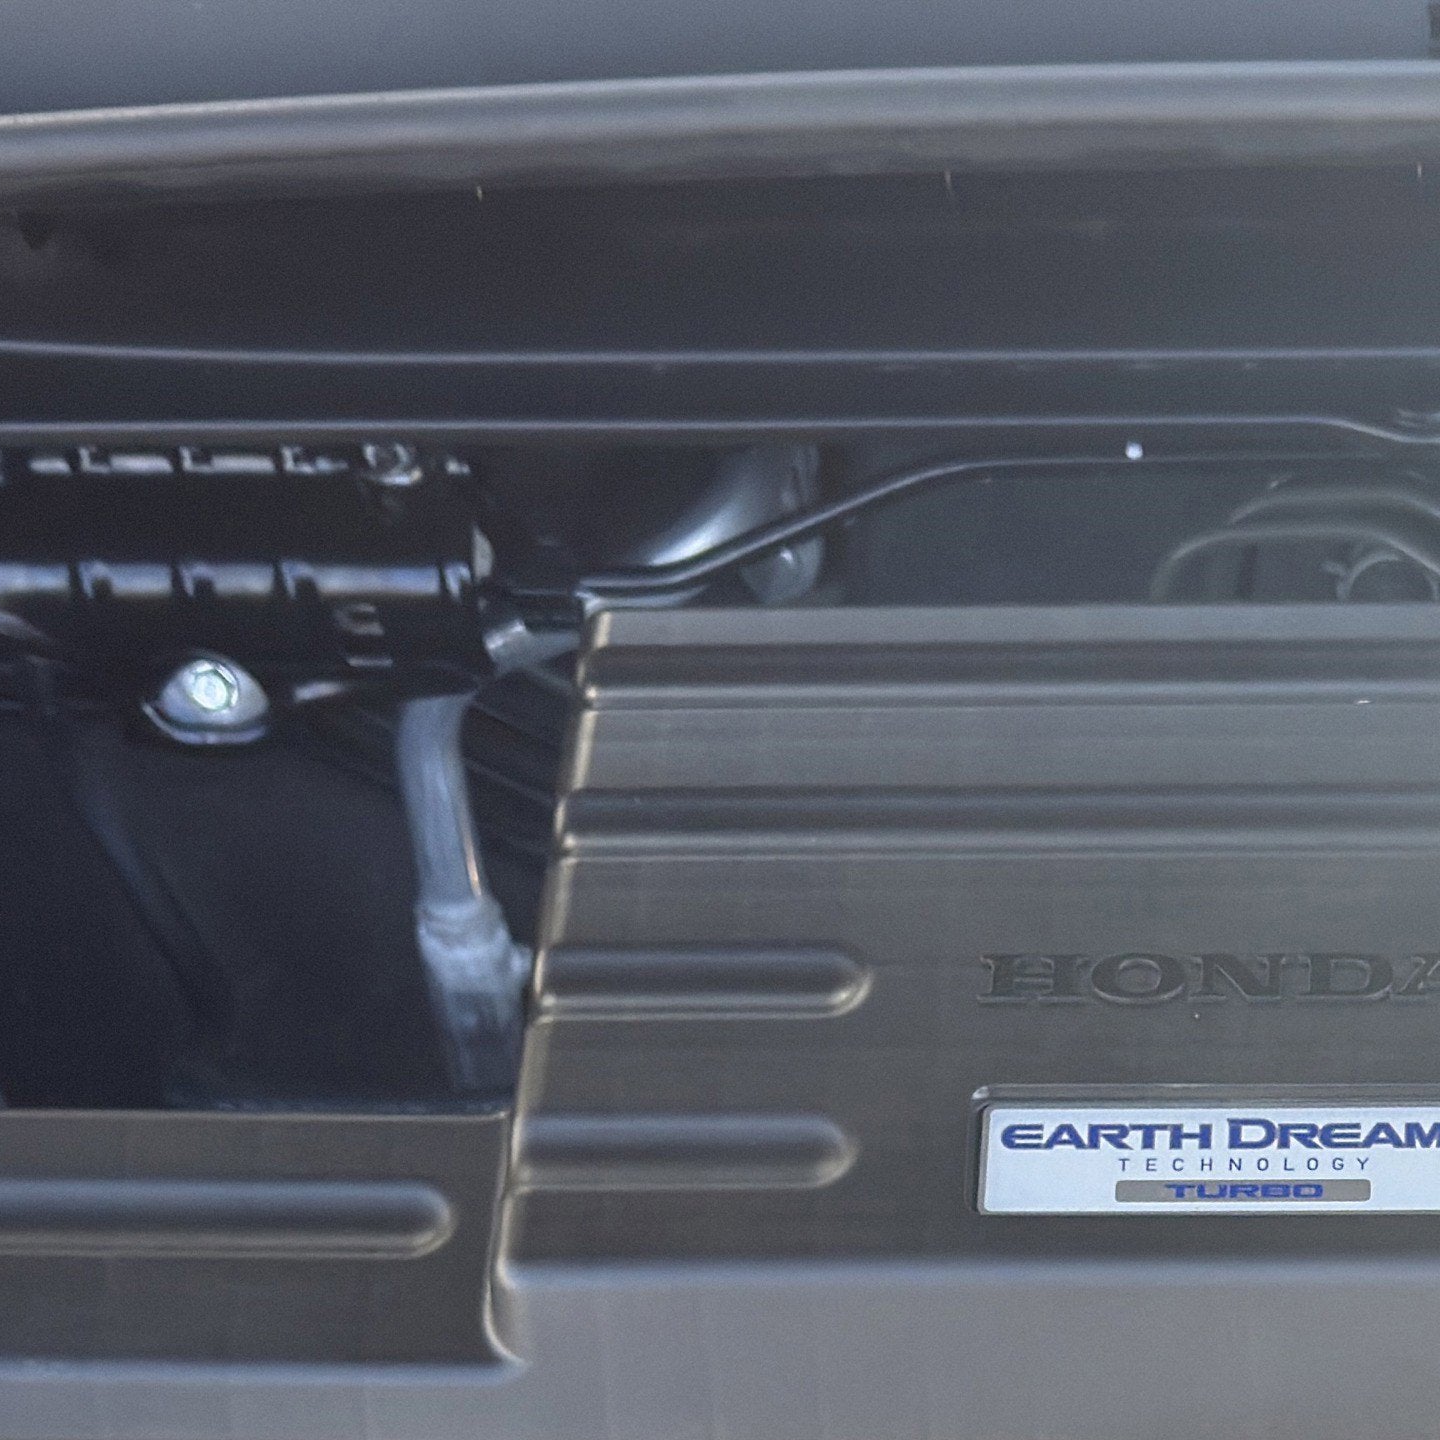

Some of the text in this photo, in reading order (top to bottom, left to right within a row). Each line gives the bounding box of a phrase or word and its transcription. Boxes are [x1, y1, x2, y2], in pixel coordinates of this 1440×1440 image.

[1000, 1121, 1213, 1151] EARTH
[1118, 1156, 1373, 1172] TECHNOLOGY
[1163, 1182, 1325, 1200] TURBO
